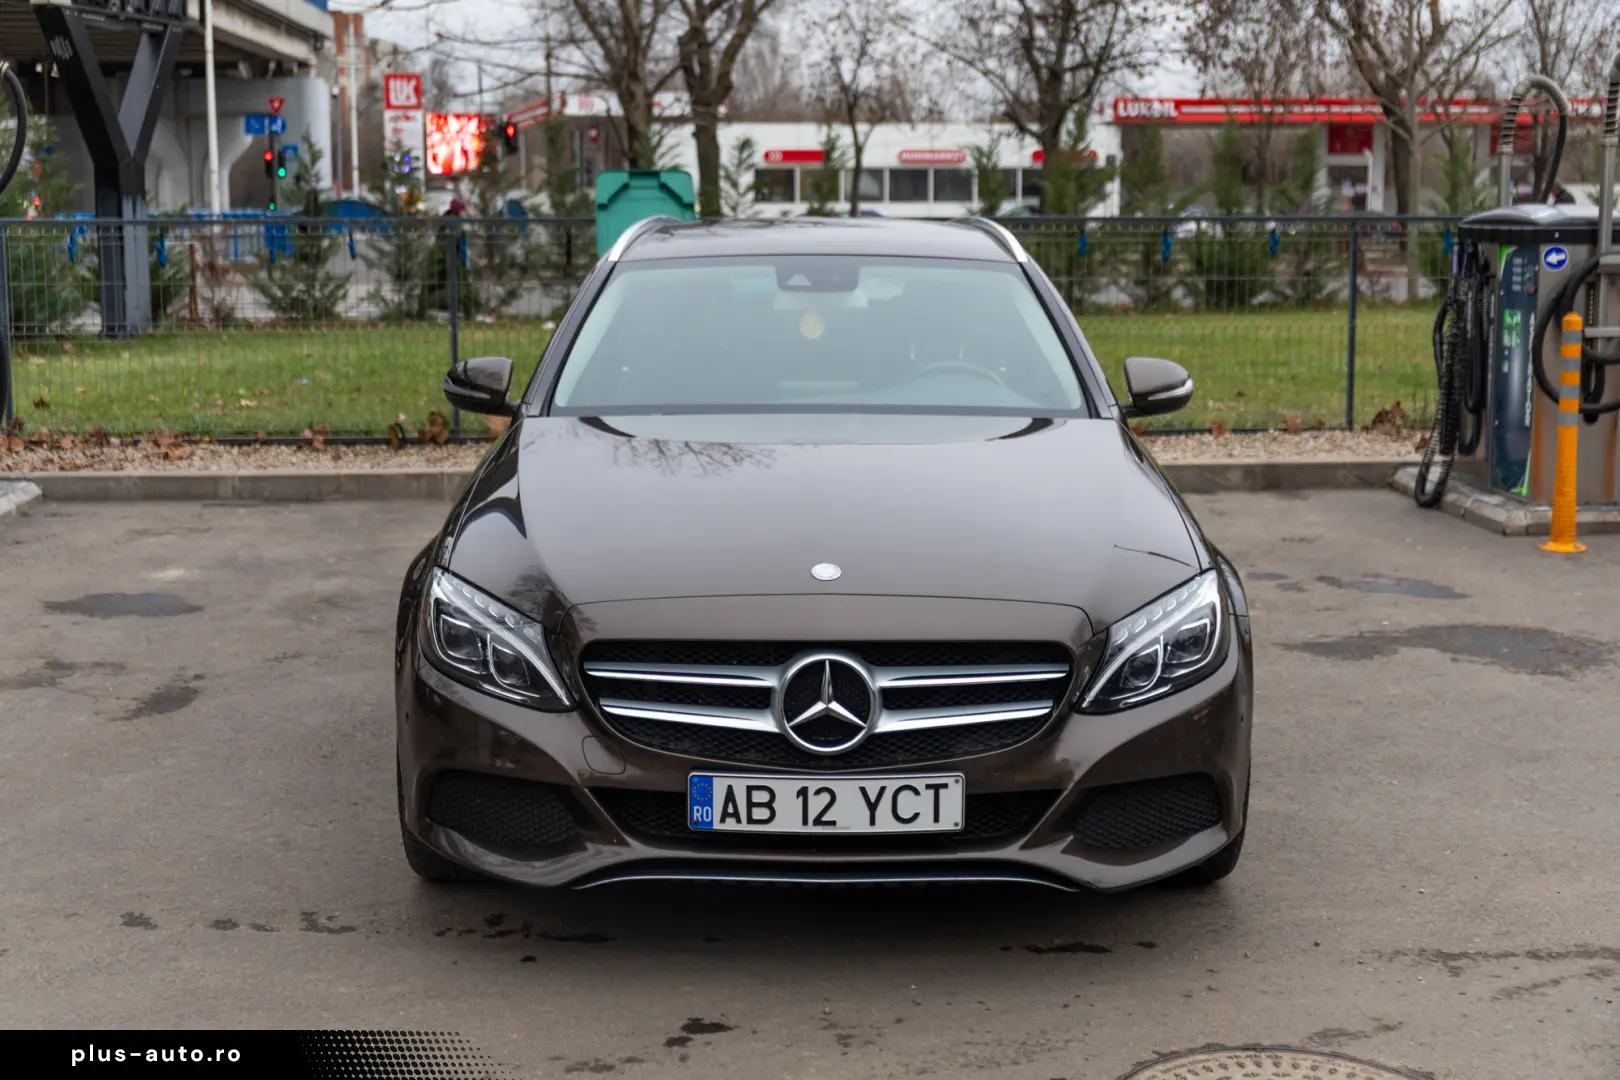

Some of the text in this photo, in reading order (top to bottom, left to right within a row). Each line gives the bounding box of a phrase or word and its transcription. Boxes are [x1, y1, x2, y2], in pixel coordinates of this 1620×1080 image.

[1117, 100, 1177, 117] LUKOIL
[693, 805, 712, 822] RO
[719, 783, 949, 827] AB 12 YCT
